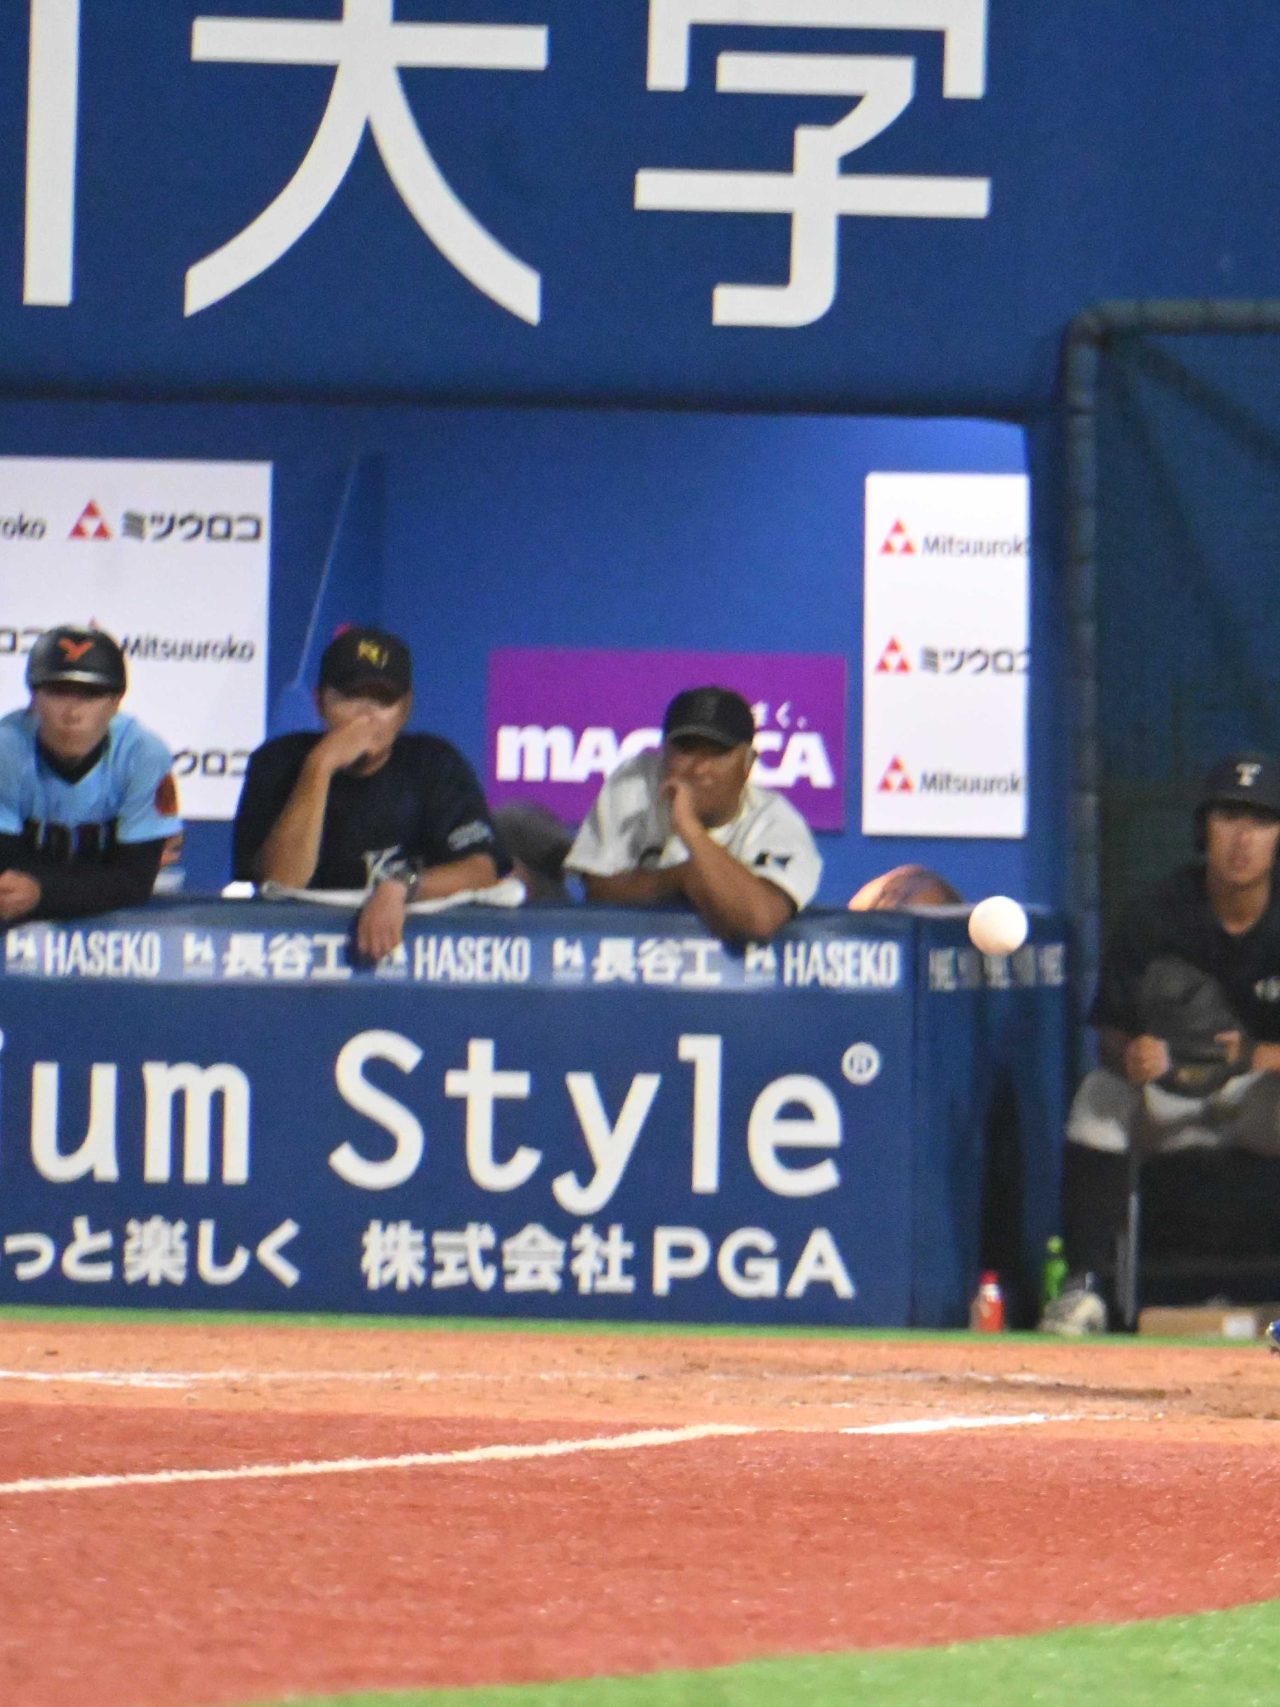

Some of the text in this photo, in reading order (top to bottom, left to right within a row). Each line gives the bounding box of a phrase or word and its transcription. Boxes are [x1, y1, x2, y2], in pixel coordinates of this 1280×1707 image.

[22, 0, 991, 328] 大学
[0, 512, 47, 541] oko
[122, 511, 262, 542] ミツウロコ
[922, 534, 1025, 557] Mitsuurok
[919, 771, 1022, 795] Mitsuurok
[44, 930, 161, 977] HASEKO
[222, 932, 353, 979] 長谷工
[414, 935, 531, 983] HASEKO
[592, 937, 722, 985] 長谷工
[783, 940, 899, 988] HASEKO
[0, 1028, 251, 1185] um
